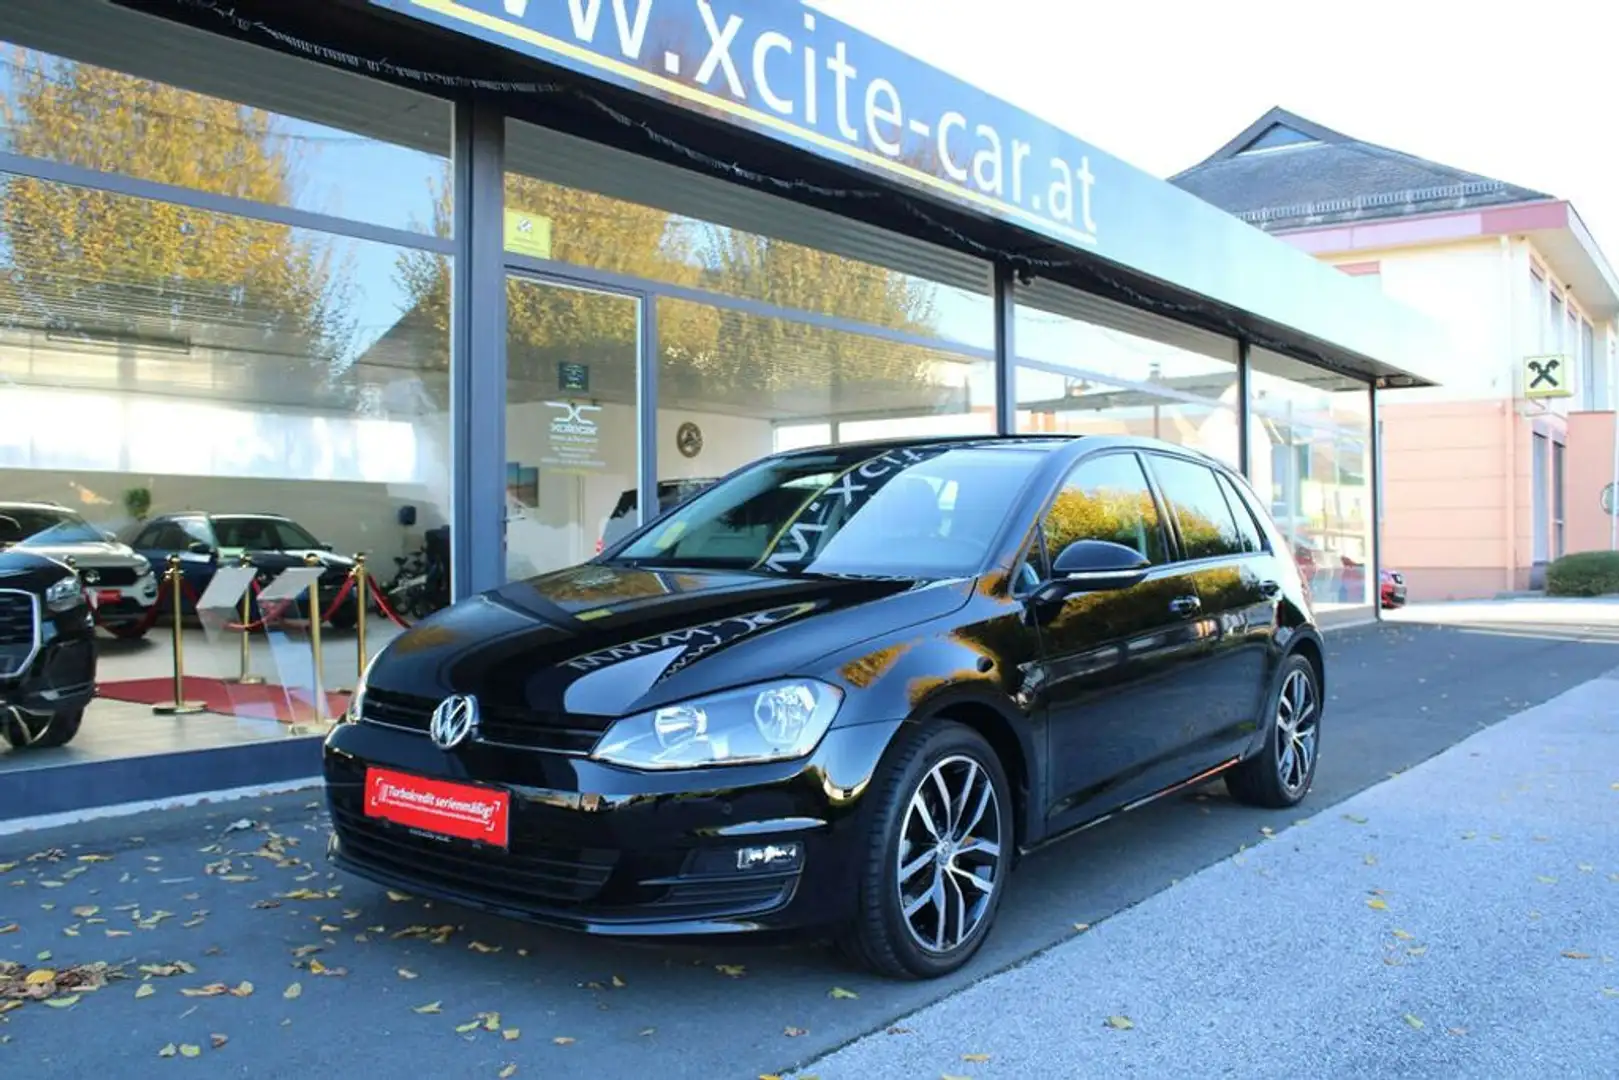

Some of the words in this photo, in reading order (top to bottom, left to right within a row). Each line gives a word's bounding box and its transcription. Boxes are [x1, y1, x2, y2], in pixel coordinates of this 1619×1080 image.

[505, 0, 1097, 234] w.xcite-car.at
[431, 695, 478, 748] VW
[388, 785, 435, 806] Turbokredit
